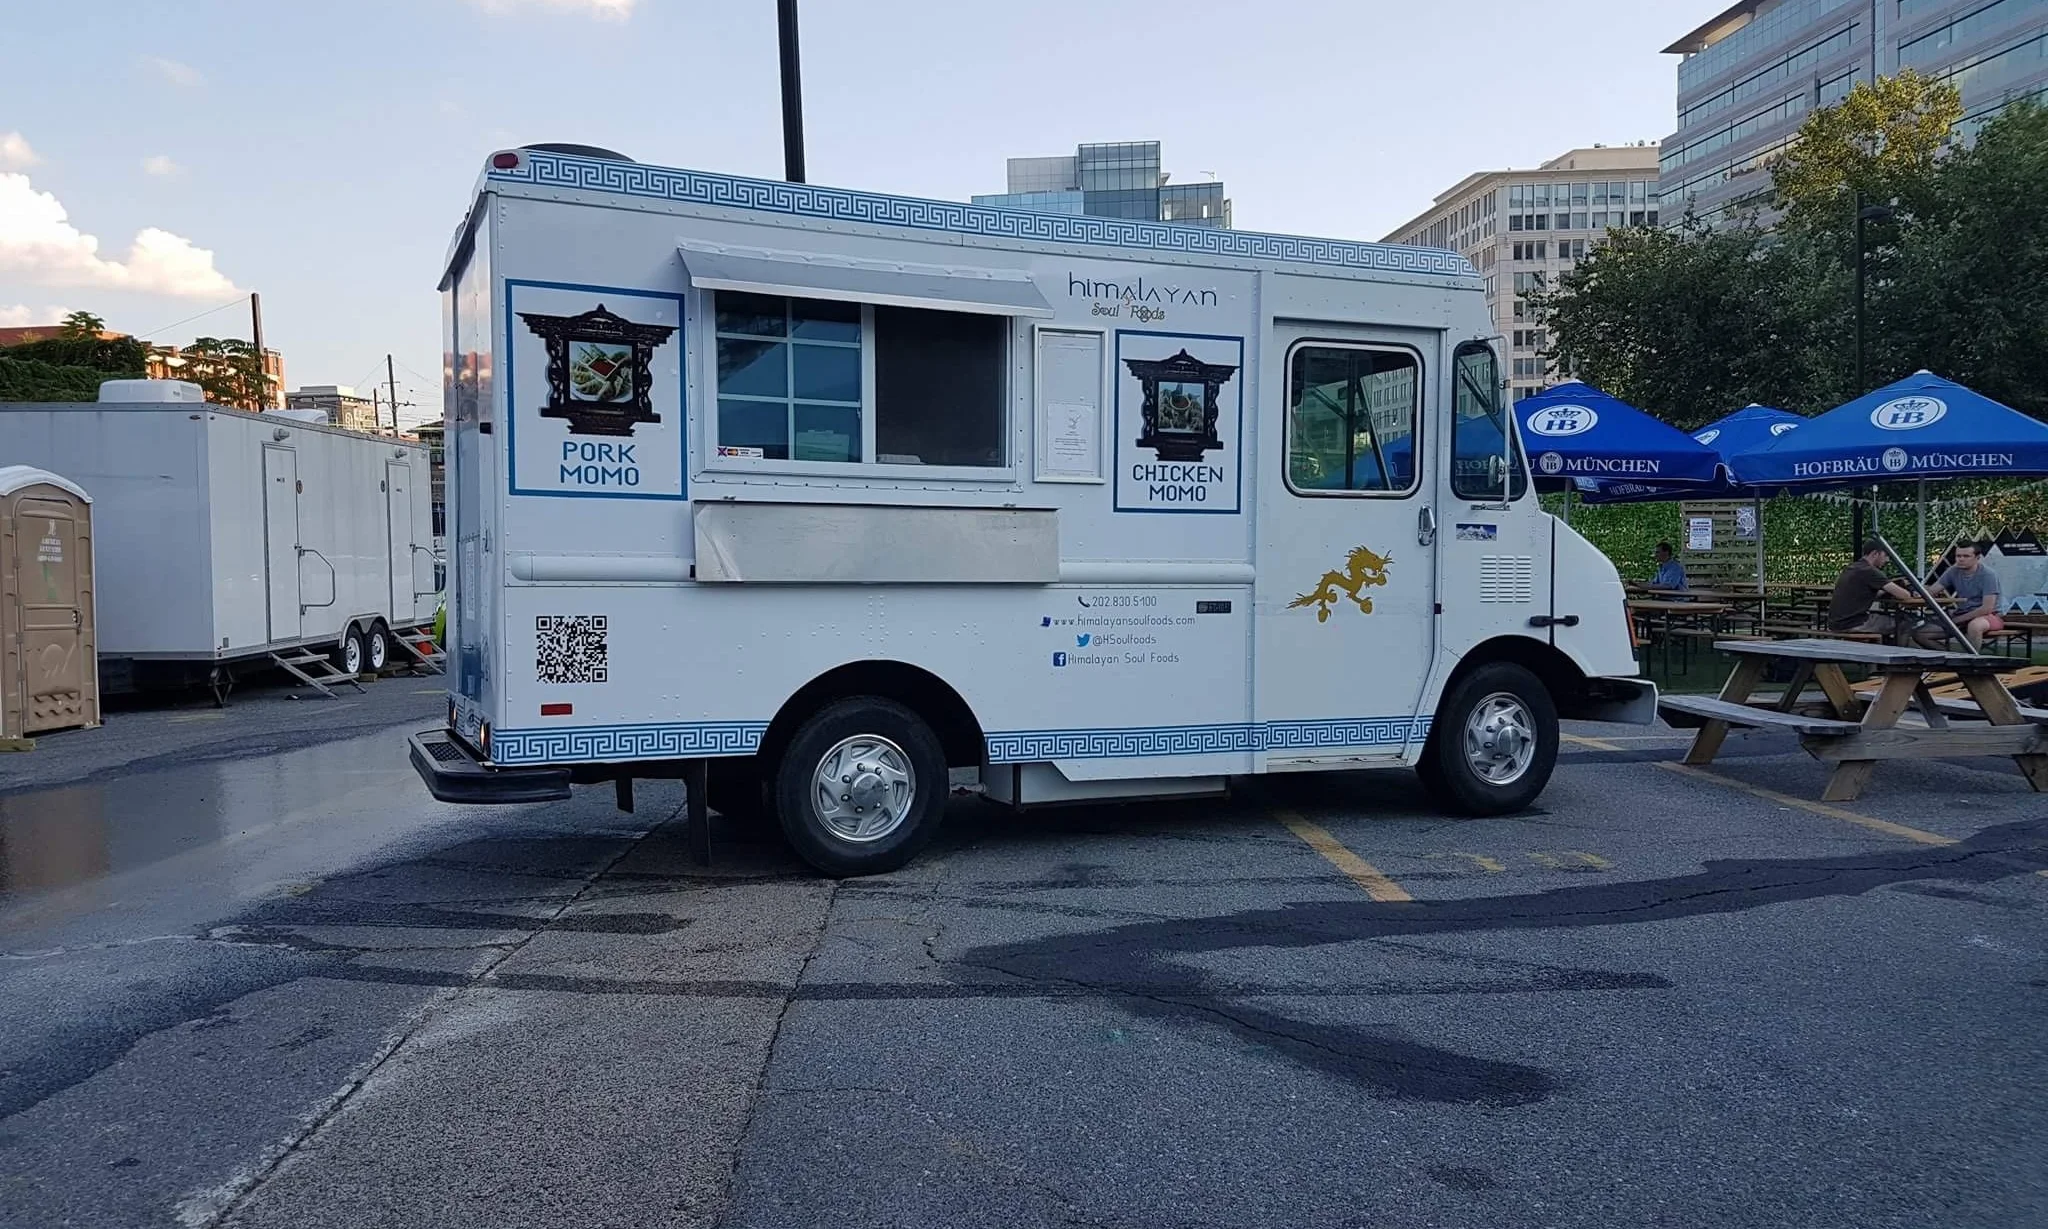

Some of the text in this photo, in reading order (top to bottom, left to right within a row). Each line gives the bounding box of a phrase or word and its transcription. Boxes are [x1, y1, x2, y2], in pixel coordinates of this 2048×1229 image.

[1091, 302, 1165, 323] Soul Foods
[1545, 420, 1577, 431] HB
[1889, 411, 1925, 425] HB
[563, 441, 636, 463] PORK
[1566, 456, 1661, 473] MÜNCHEN
[1794, 456, 1880, 476] HOFBRÄU
[1912, 452, 2013, 469] MÜNCHEN
[560, 464, 639, 486] MOMO
[1132, 464, 1223, 483] CHICKEN
[1149, 485, 1207, 502] MOMO
[1053, 614, 1196, 629] www.himalayansoulfoods.com
[1068, 653, 1120, 667] Himalayan
[1124, 652, 1146, 663] Soul
[1150, 652, 1180, 663] Foods
